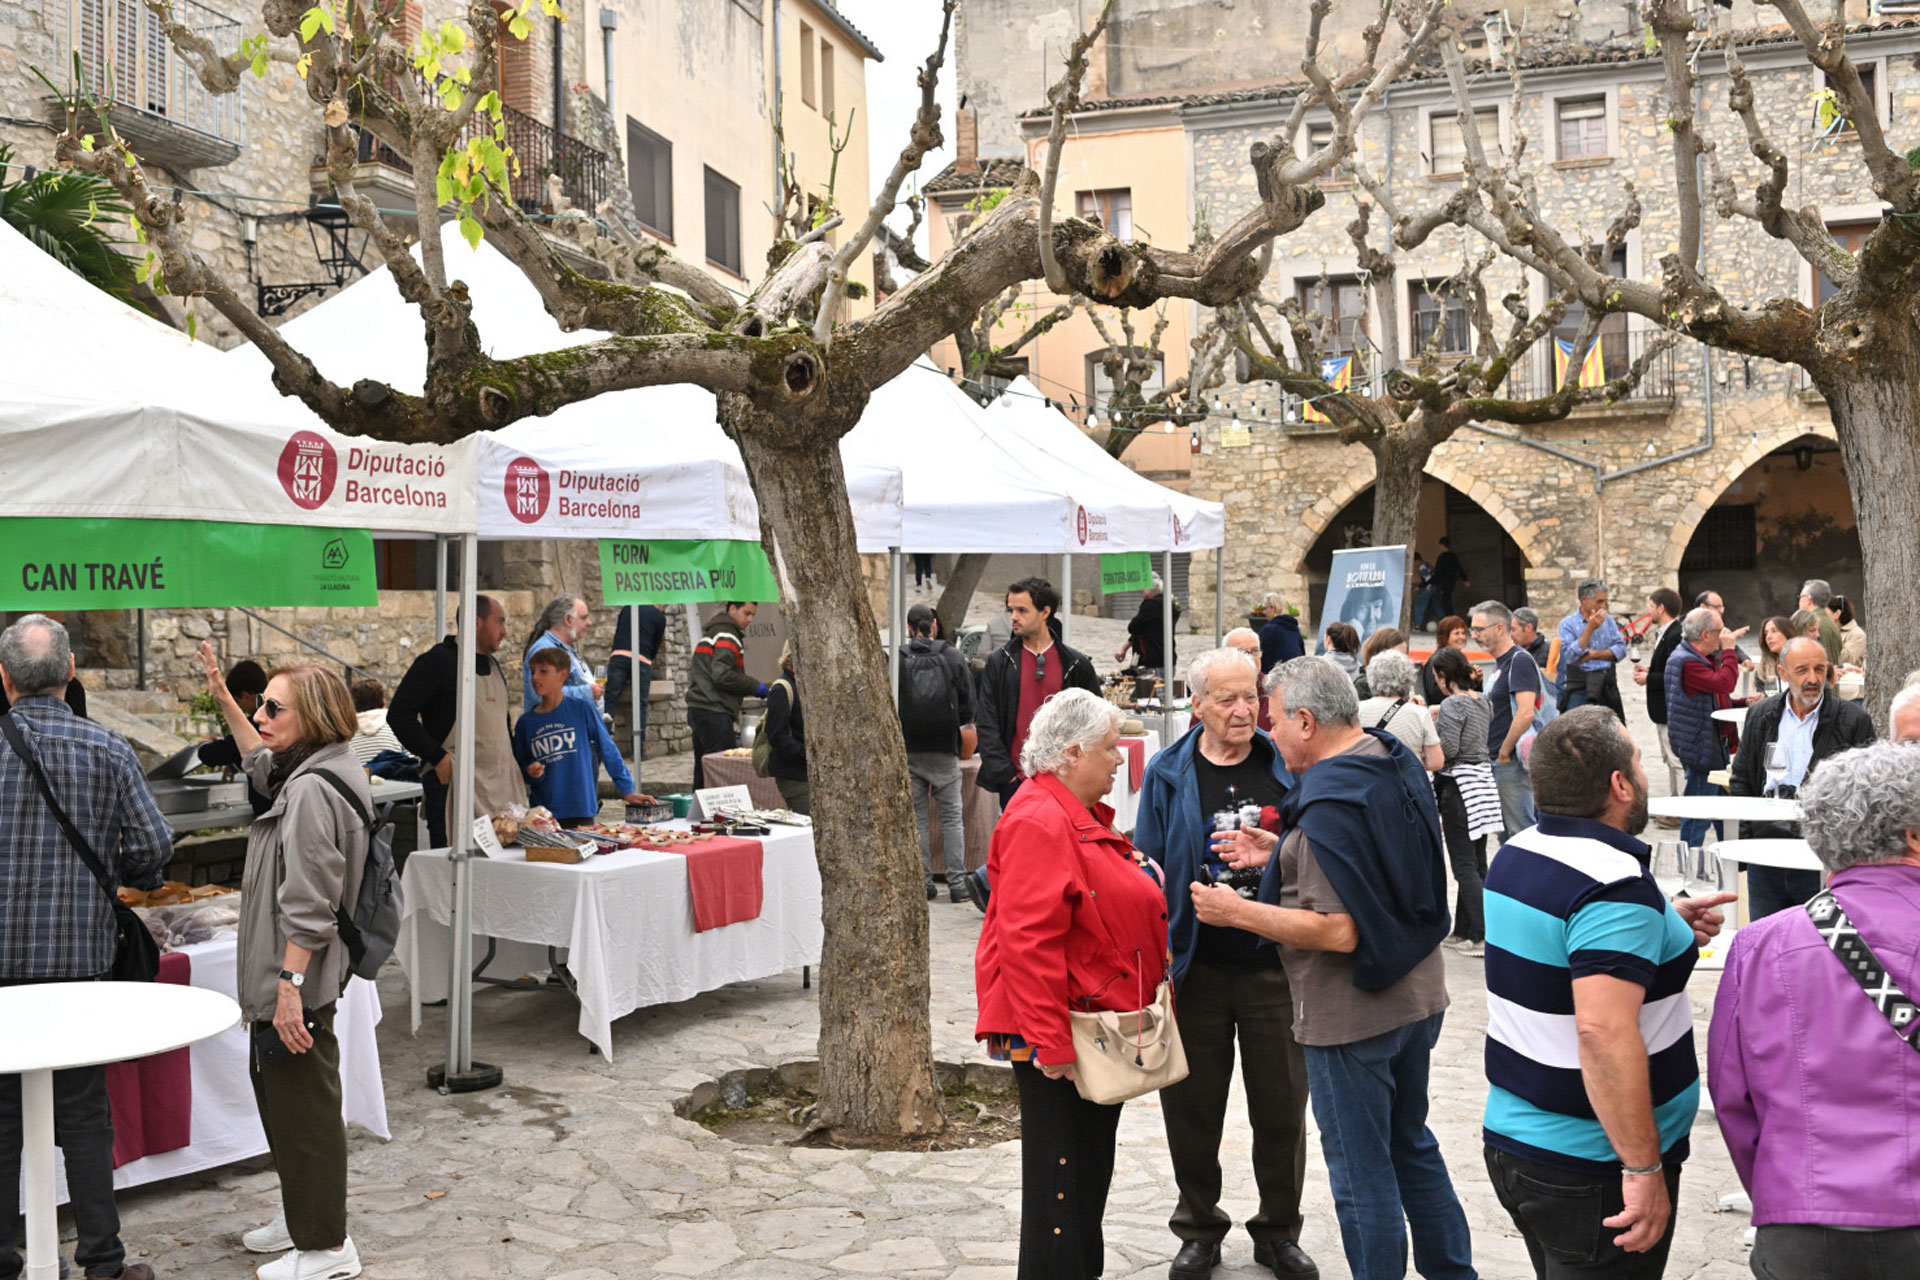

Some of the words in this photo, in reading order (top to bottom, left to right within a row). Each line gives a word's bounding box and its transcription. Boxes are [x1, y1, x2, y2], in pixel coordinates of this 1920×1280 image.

[347, 447, 445, 478] Diputació
[345, 479, 447, 508] Barcelona
[559, 470, 640, 494] Diputació
[559, 496, 640, 519] Barcelona
[613, 544, 649, 565] FORN
[22, 562, 77, 592] CAN
[84, 555, 165, 591] TRAVÉ
[615, 570, 707, 592] PASTISSERIA
[531, 731, 576, 759] INDY
